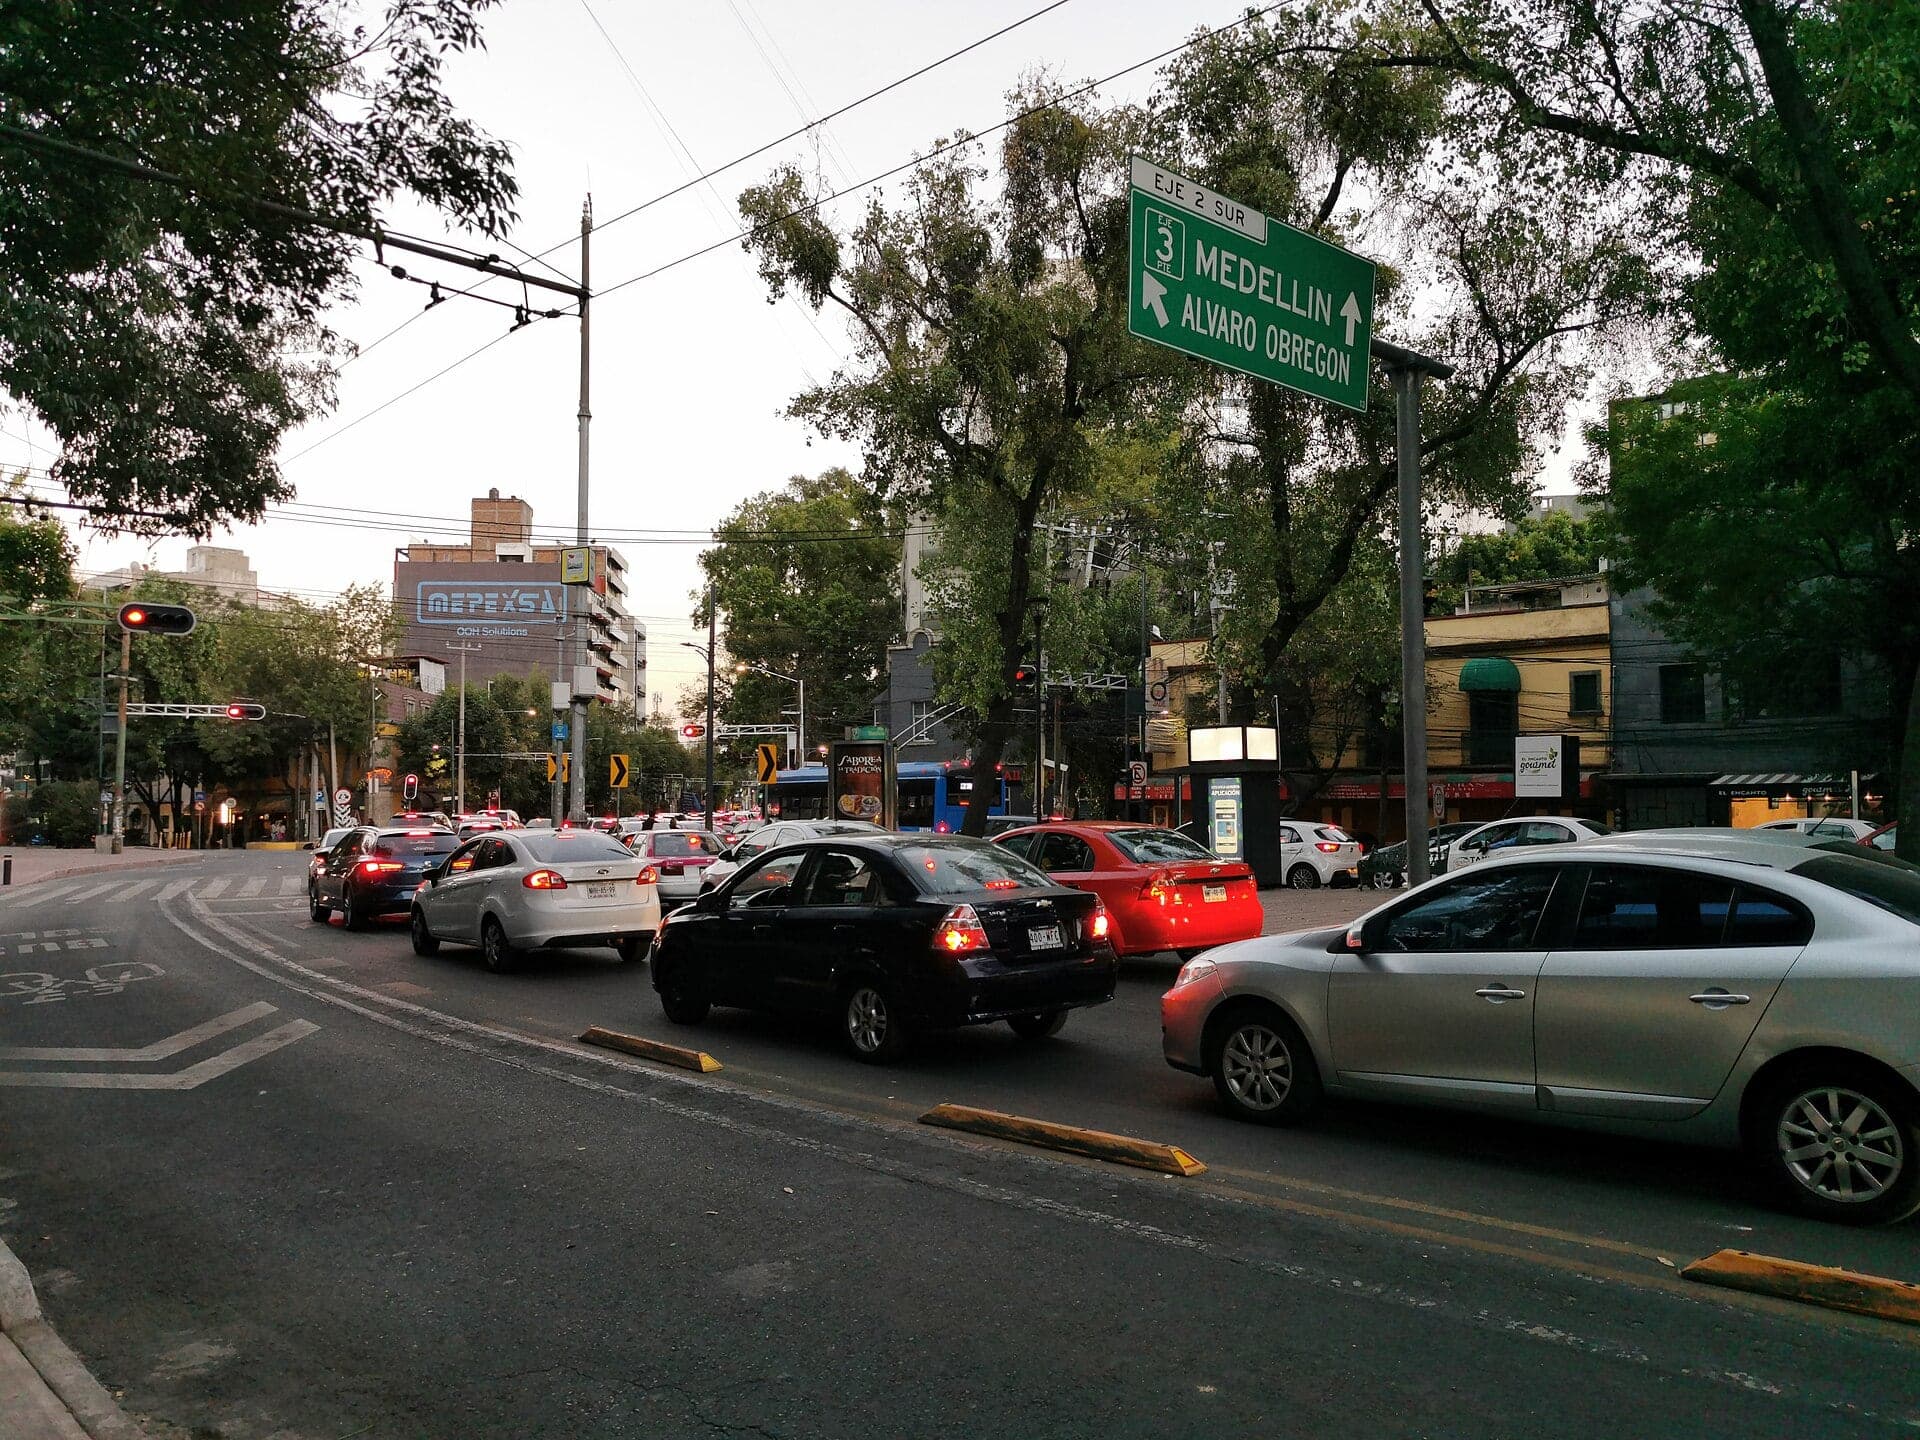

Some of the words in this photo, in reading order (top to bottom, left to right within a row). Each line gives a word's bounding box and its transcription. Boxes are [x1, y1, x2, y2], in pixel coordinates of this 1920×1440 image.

[1154, 173, 1185, 201] EJE
[1195, 191, 1204, 209] 2
[1214, 200, 1245, 227] SUR
[1157, 214, 1173, 229] EJE
[1155, 226, 1174, 263] 3
[1157, 260, 1172, 274] PTE
[1195, 239, 1332, 327] MEDELLIN
[1181, 292, 1257, 352] ALVARO
[1265, 324, 1351, 386] OBREGON
[427, 588, 557, 614] MEPEXSA
[482, 626, 529, 637] Solutions
[837, 755, 882, 767] SABOREA
